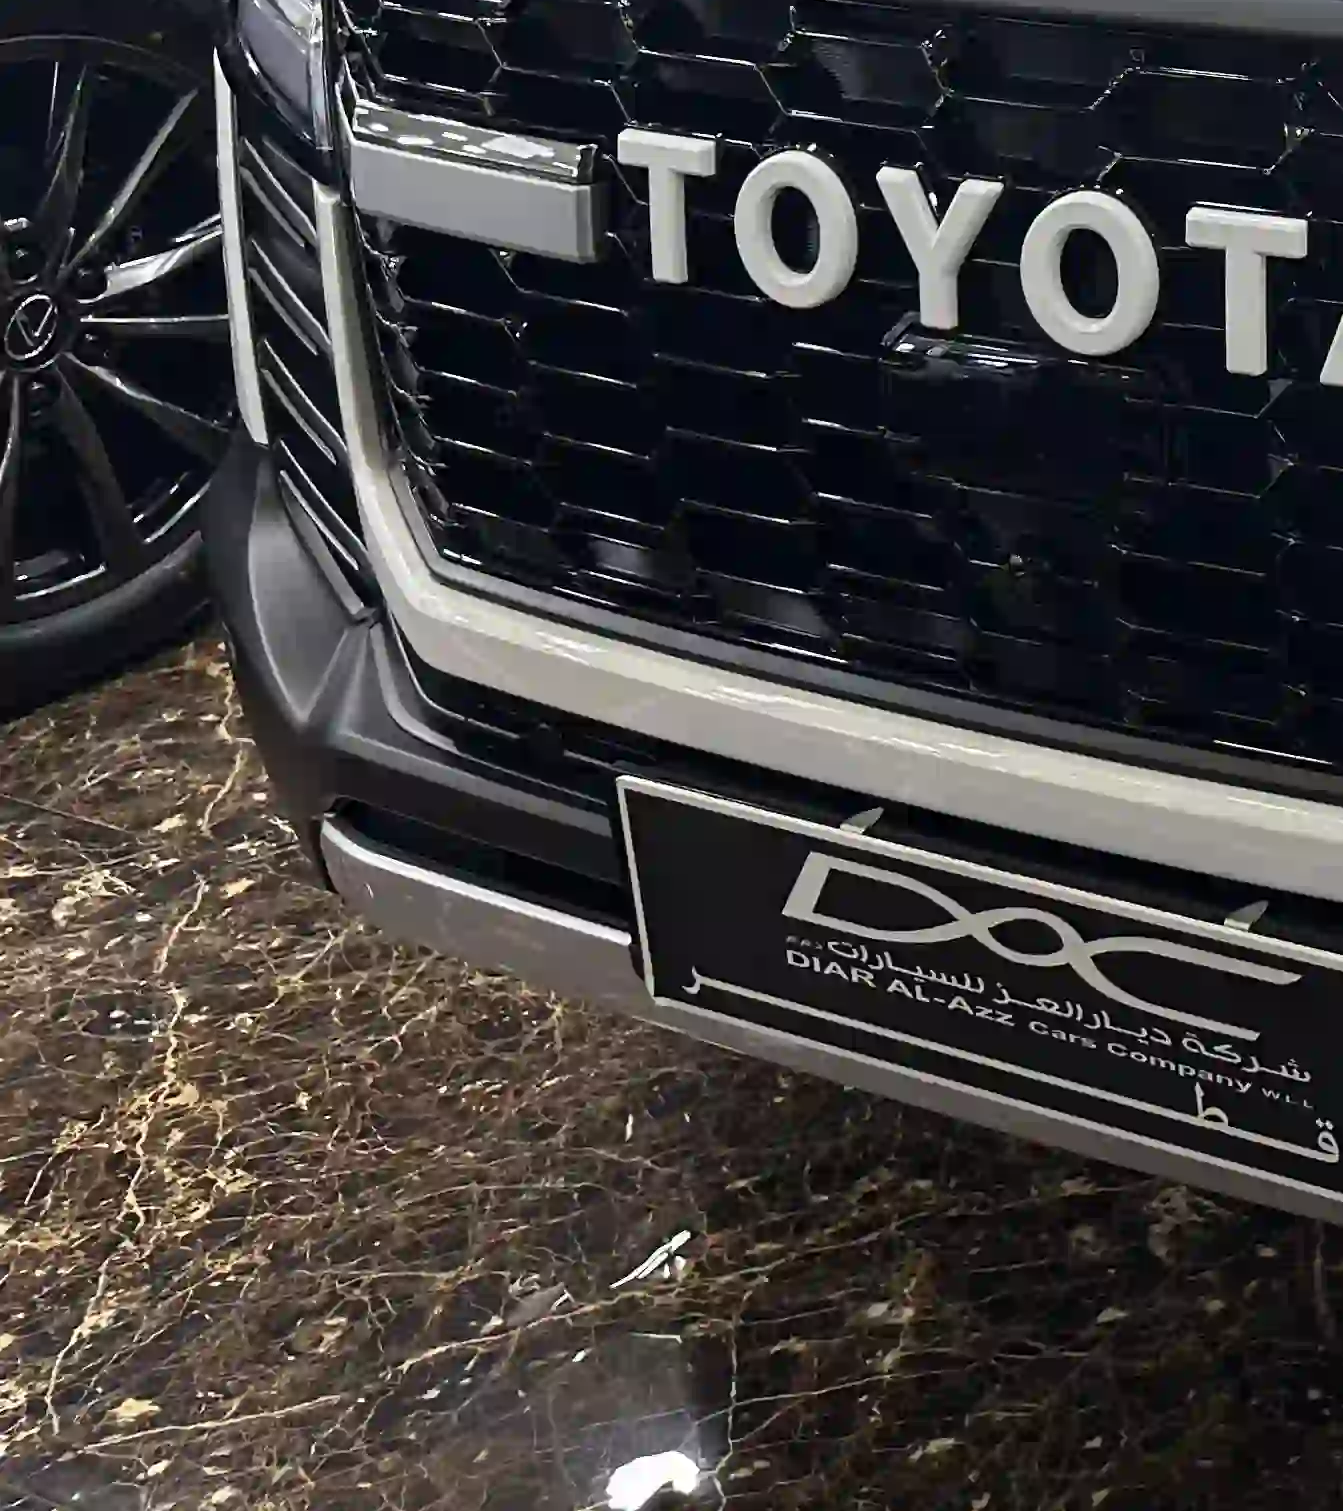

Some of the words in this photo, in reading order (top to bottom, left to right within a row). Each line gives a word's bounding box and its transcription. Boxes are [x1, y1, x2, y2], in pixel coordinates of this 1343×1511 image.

[827, 940, 985, 995] للسيارات
[786, 949, 877, 988] DIAR
[1028, 1021, 1097, 1050] Cars
[1107, 1042, 1253, 1094] Company
[991, 981, 1083, 1022] العز
[1084, 1010, 1173, 1047] ديار
[1181, 1031, 1312, 1084] شركة
